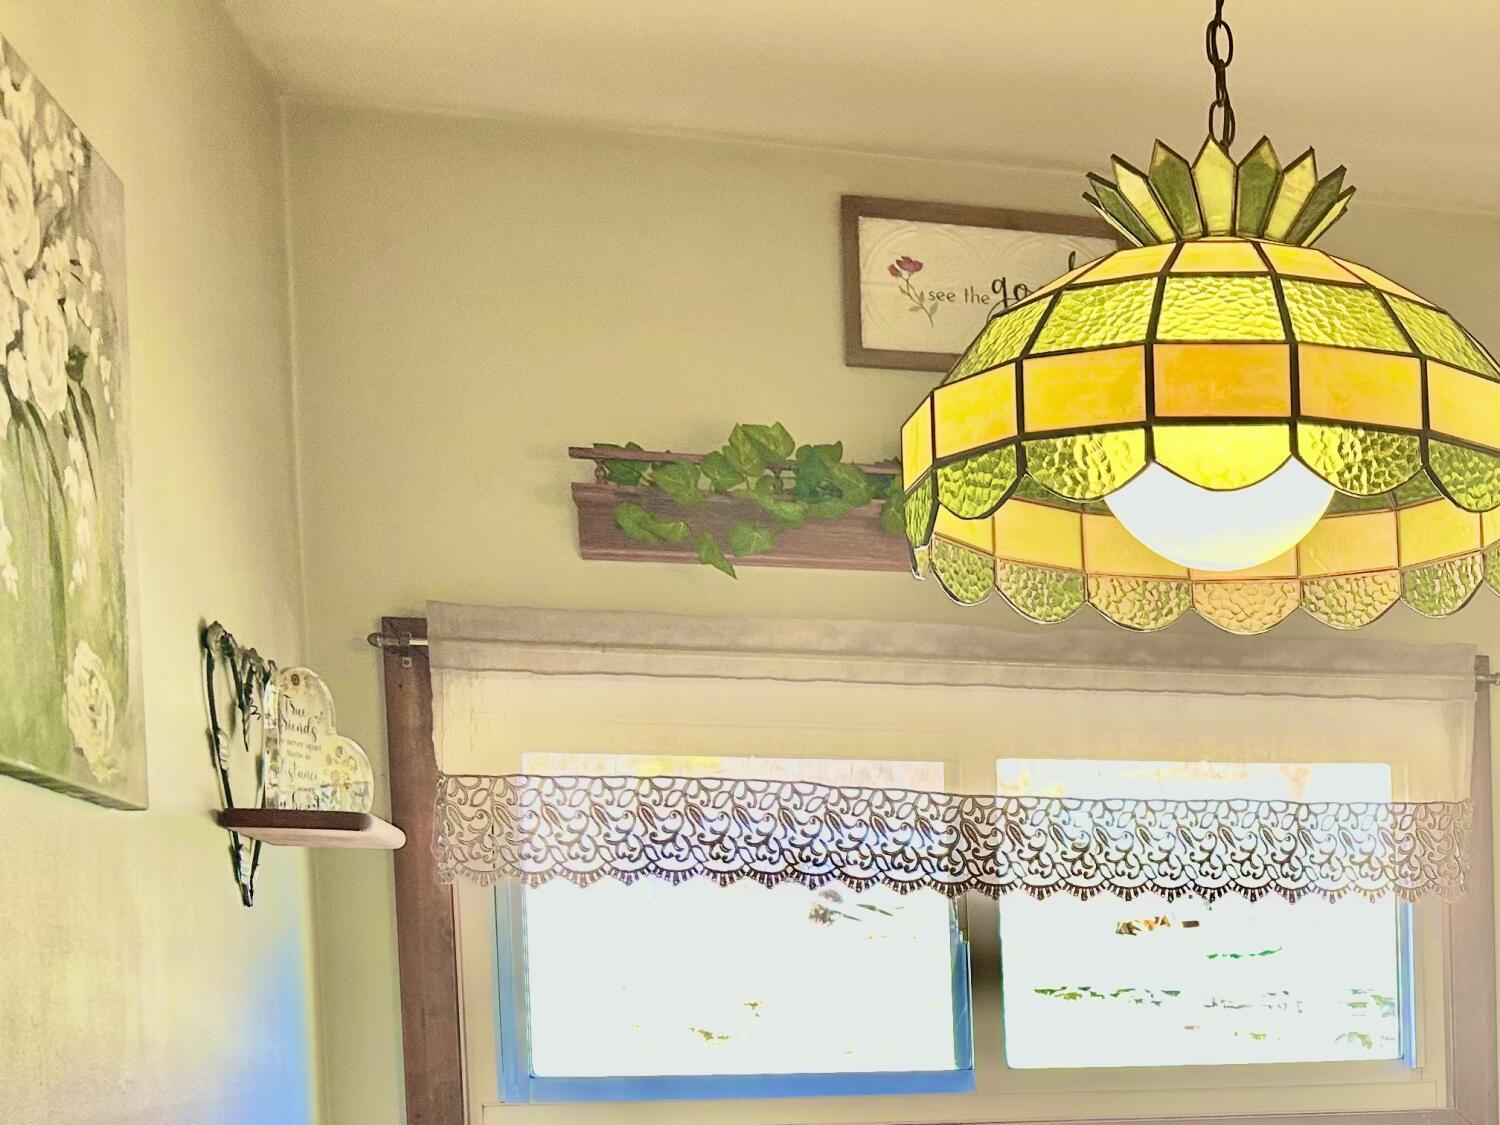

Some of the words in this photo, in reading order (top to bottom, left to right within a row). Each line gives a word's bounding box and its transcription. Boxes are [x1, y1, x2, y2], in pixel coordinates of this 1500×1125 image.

[928, 290, 956, 303] see
[964, 285, 991, 306] the
[280, 717, 317, 743] riends
